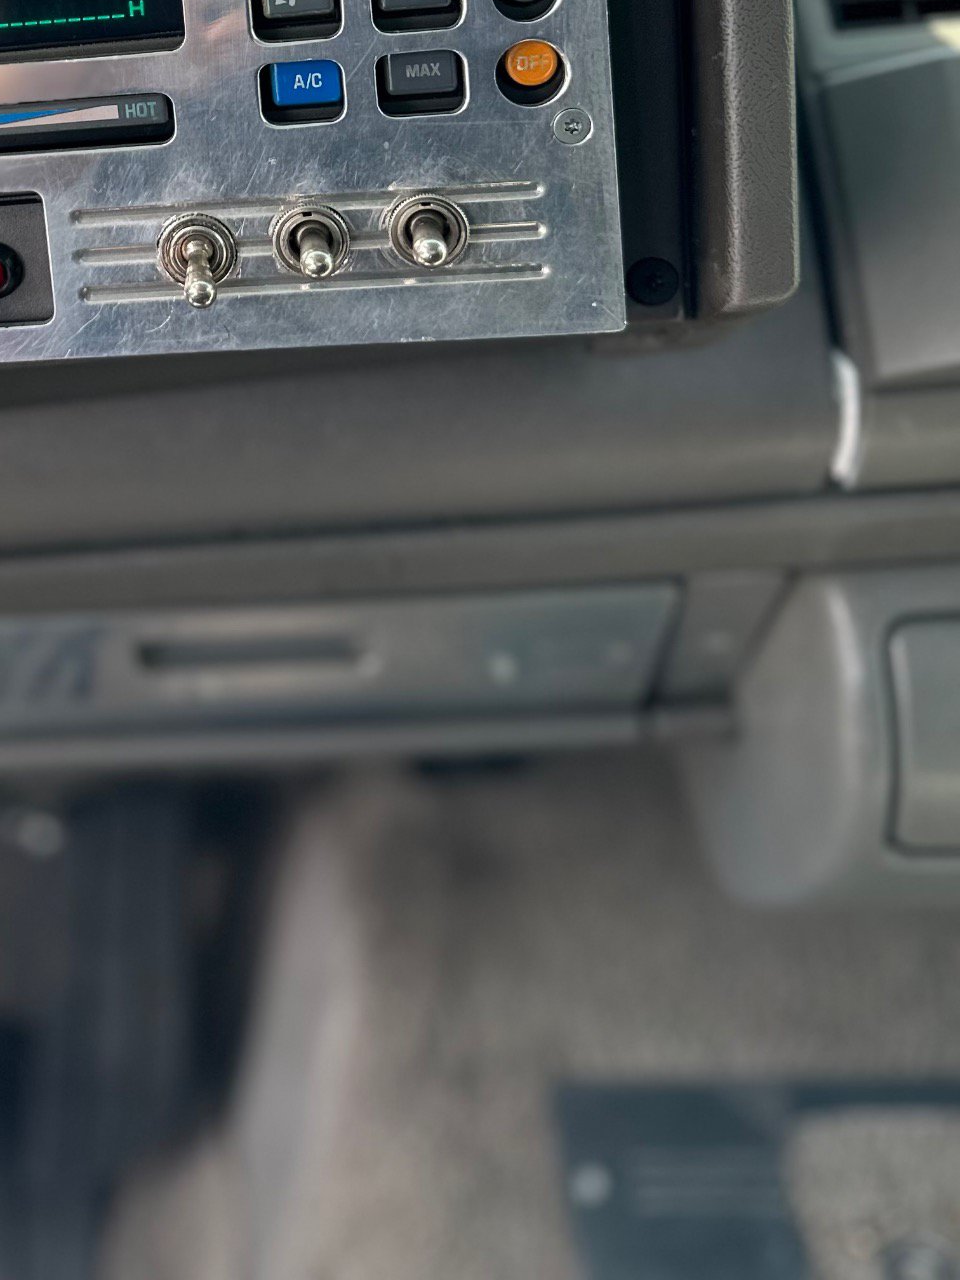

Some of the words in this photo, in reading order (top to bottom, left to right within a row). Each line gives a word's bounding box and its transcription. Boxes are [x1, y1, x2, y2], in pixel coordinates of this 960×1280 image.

[128, 0, 145, 17] H
[405, 62, 441, 79] MAX
[516, 54, 552, 71] OFF
[293, 72, 323, 90] A/C
[125, 101, 157, 119] HOT
